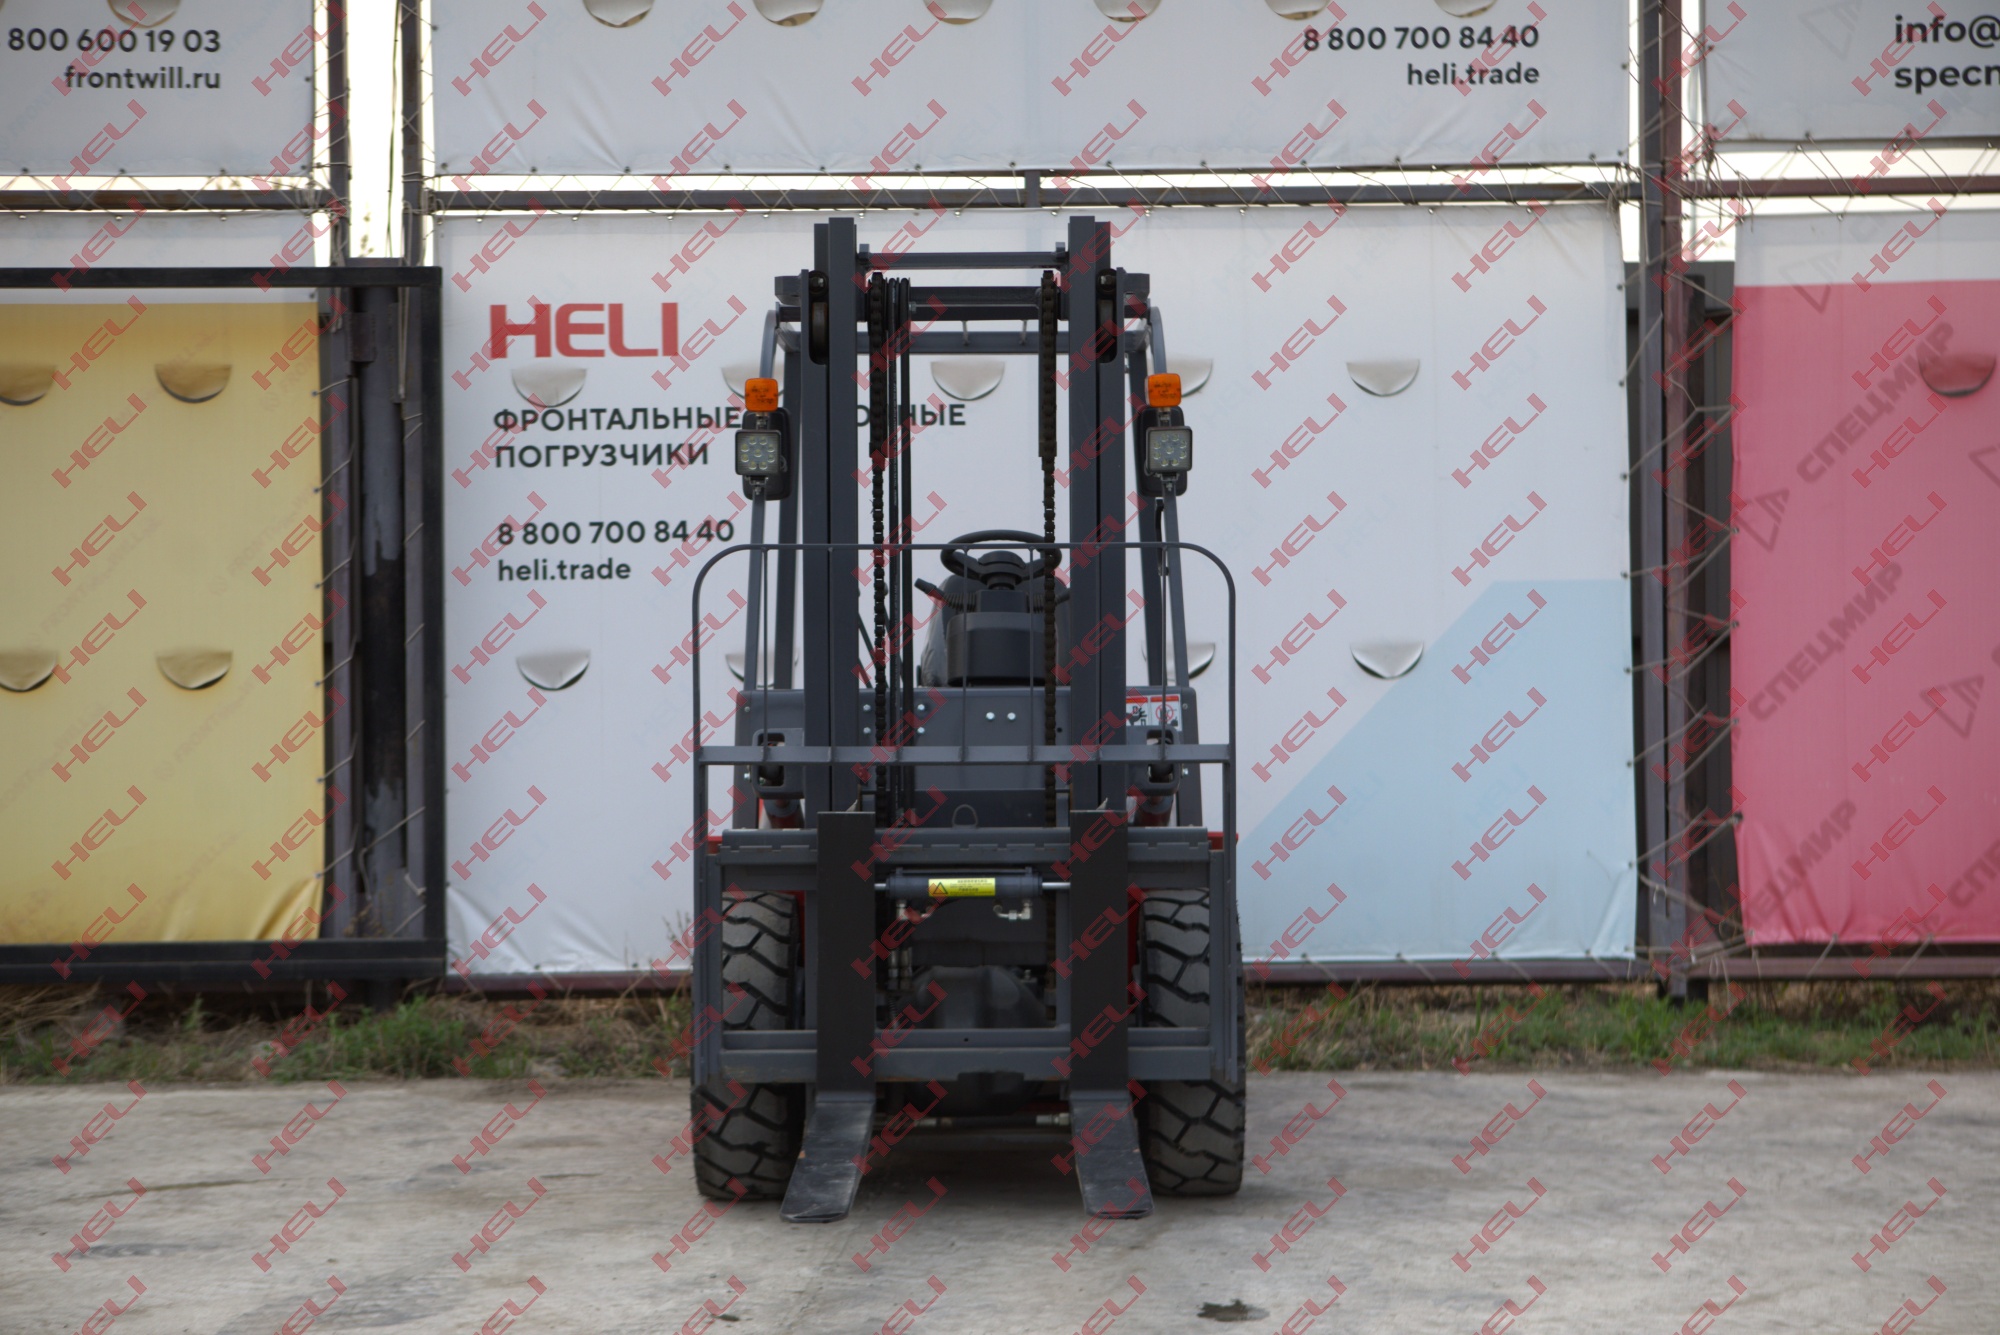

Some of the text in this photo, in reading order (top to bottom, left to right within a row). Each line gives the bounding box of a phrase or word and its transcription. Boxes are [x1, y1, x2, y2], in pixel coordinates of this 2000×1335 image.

[8, 28, 221, 52] 800 600 19 03
[1303, 25, 1540, 51] 8 800 700 84 40
[1895, 14, 2000, 49] info@
[64, 66, 221, 89] frontwill.ru
[1407, 62, 1540, 85] heli.trade
[490, 302, 678, 358] HELI
[1796, 321, 1954, 484] СПЕЦМИР
[494, 406, 742, 431] ФРОНТАЛЬНЫЕ
[495, 443, 709, 468] ПОГРУЗЧИКИ
[497, 519, 735, 546] 8 800 700 84 40
[498, 557, 632, 581] heli.trade
[1748, 561, 1903, 722] СПЕЦМИР
